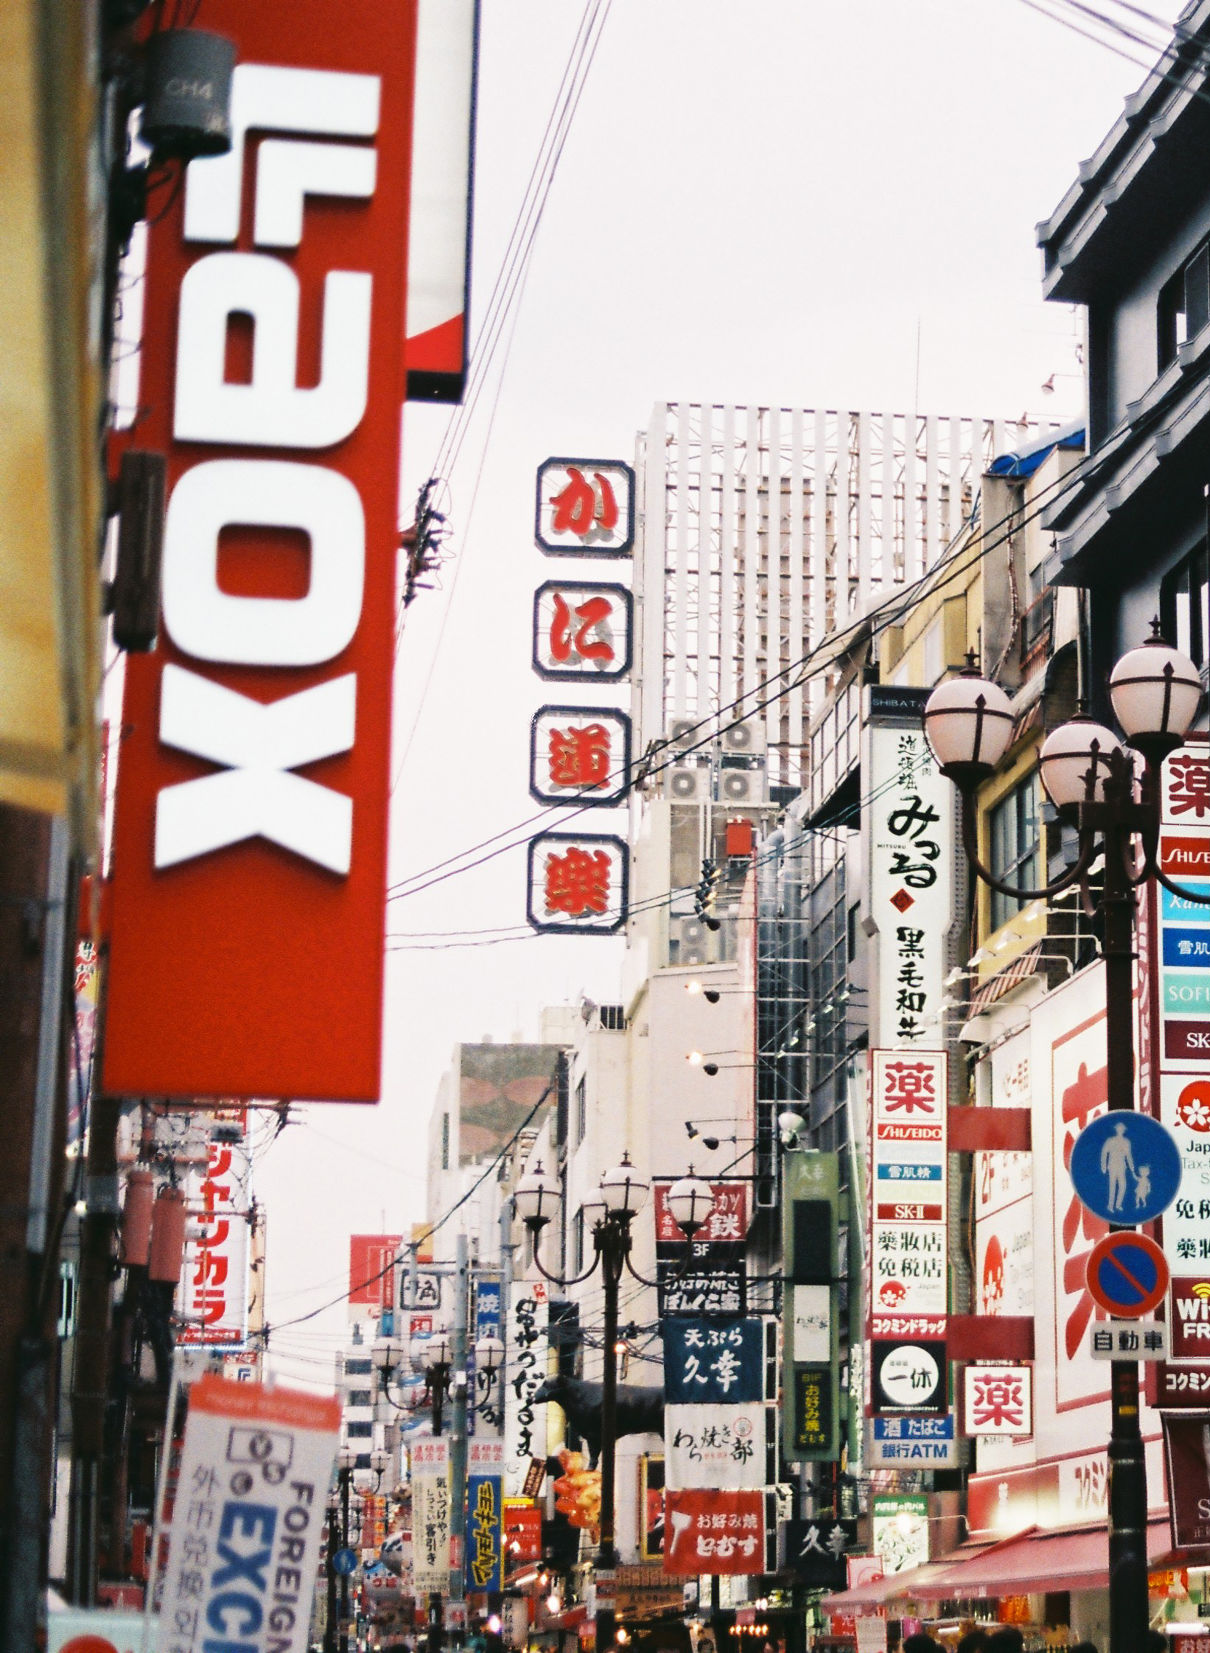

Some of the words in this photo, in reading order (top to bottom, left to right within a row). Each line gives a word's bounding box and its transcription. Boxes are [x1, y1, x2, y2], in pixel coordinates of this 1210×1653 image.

[895, 926, 927, 1040] 黒毛和牛
[885, 1061, 935, 1113] 薬
[878, 1126, 942, 1139] SHISEIDO
[693, 1243, 710, 1257] 3F
[684, 1327, 743, 1347] 天ぷら
[872, 1318, 947, 1335] コクミンドラッグ
[1094, 1331, 1165, 1352] 自動車
[683, 1349, 742, 1392] 久幸
[887, 1366, 932, 1390] 一休
[973, 1374, 1023, 1426] 薬
[908, 1419, 947, 1436] たばこ
[882, 1443, 948, 1459] 銀行ATM
[697, 1513, 759, 1529] お好み焼
[799, 1524, 849, 1562] 久幸
[268, 1478, 315, 1653] FOREIGN
